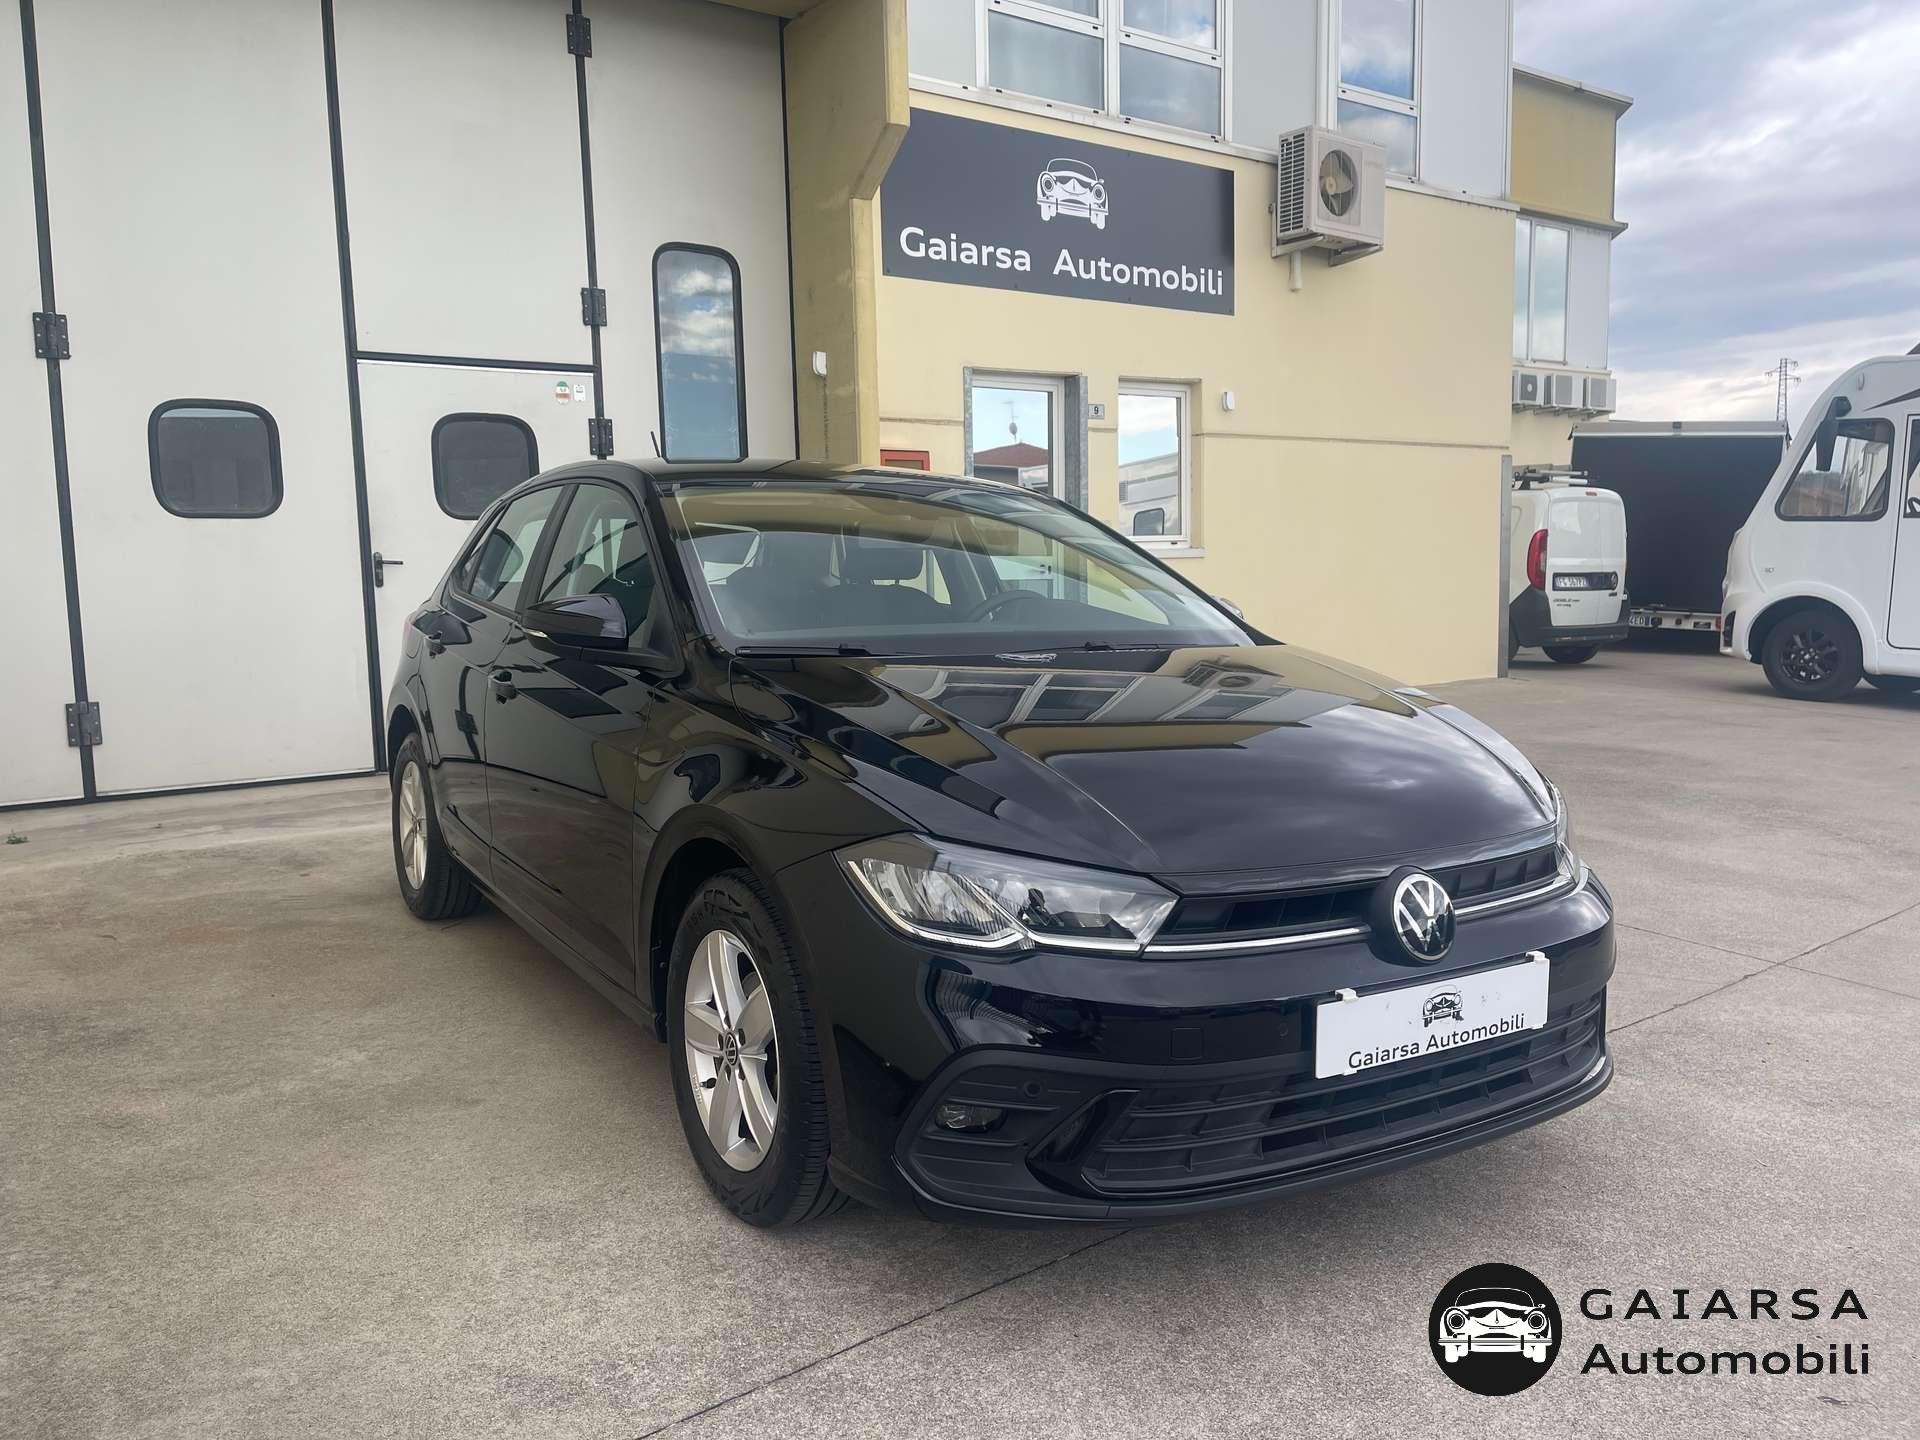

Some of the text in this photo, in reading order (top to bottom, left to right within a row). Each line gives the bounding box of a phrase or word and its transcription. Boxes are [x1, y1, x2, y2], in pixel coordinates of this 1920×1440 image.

[900, 226, 1223, 295] Gaiarsa Automobili
[1093, 406, 1099, 415] 9
[1348, 1013, 1525, 1069] Gaiarsa Automobili
